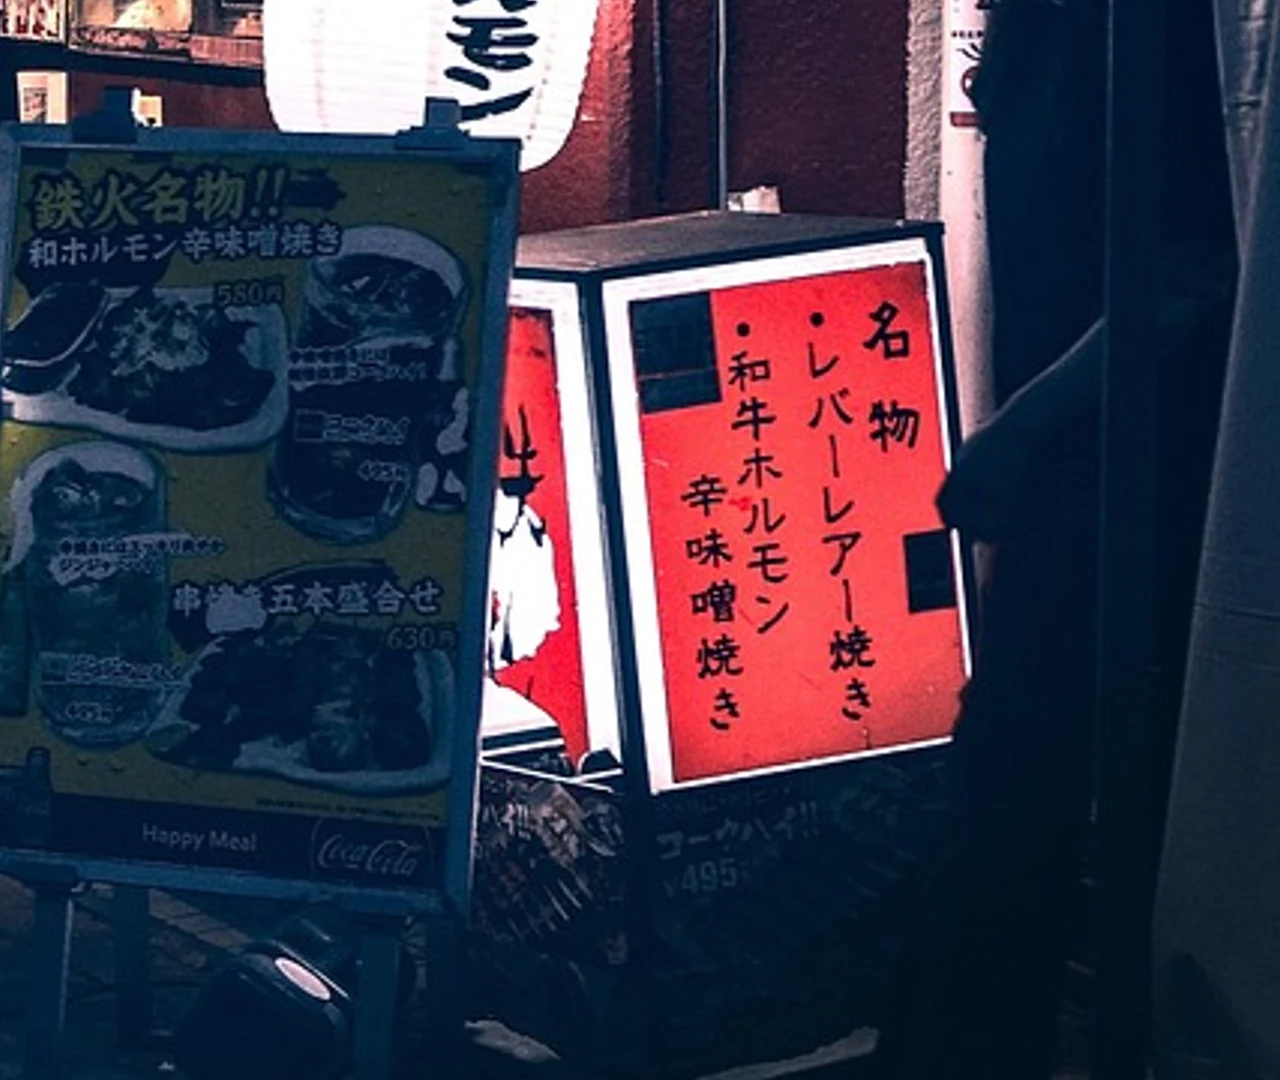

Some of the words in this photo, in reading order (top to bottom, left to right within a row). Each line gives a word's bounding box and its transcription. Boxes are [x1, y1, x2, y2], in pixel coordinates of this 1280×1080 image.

[27, 222, 341, 270] 和ホルモン辛味噌焼き
[863, 301, 921, 452] 名物
[680, 474, 743, 732] 辛味噌焼き
[141, 823, 206, 851] Happy
[208, 829, 259, 853] Meal
